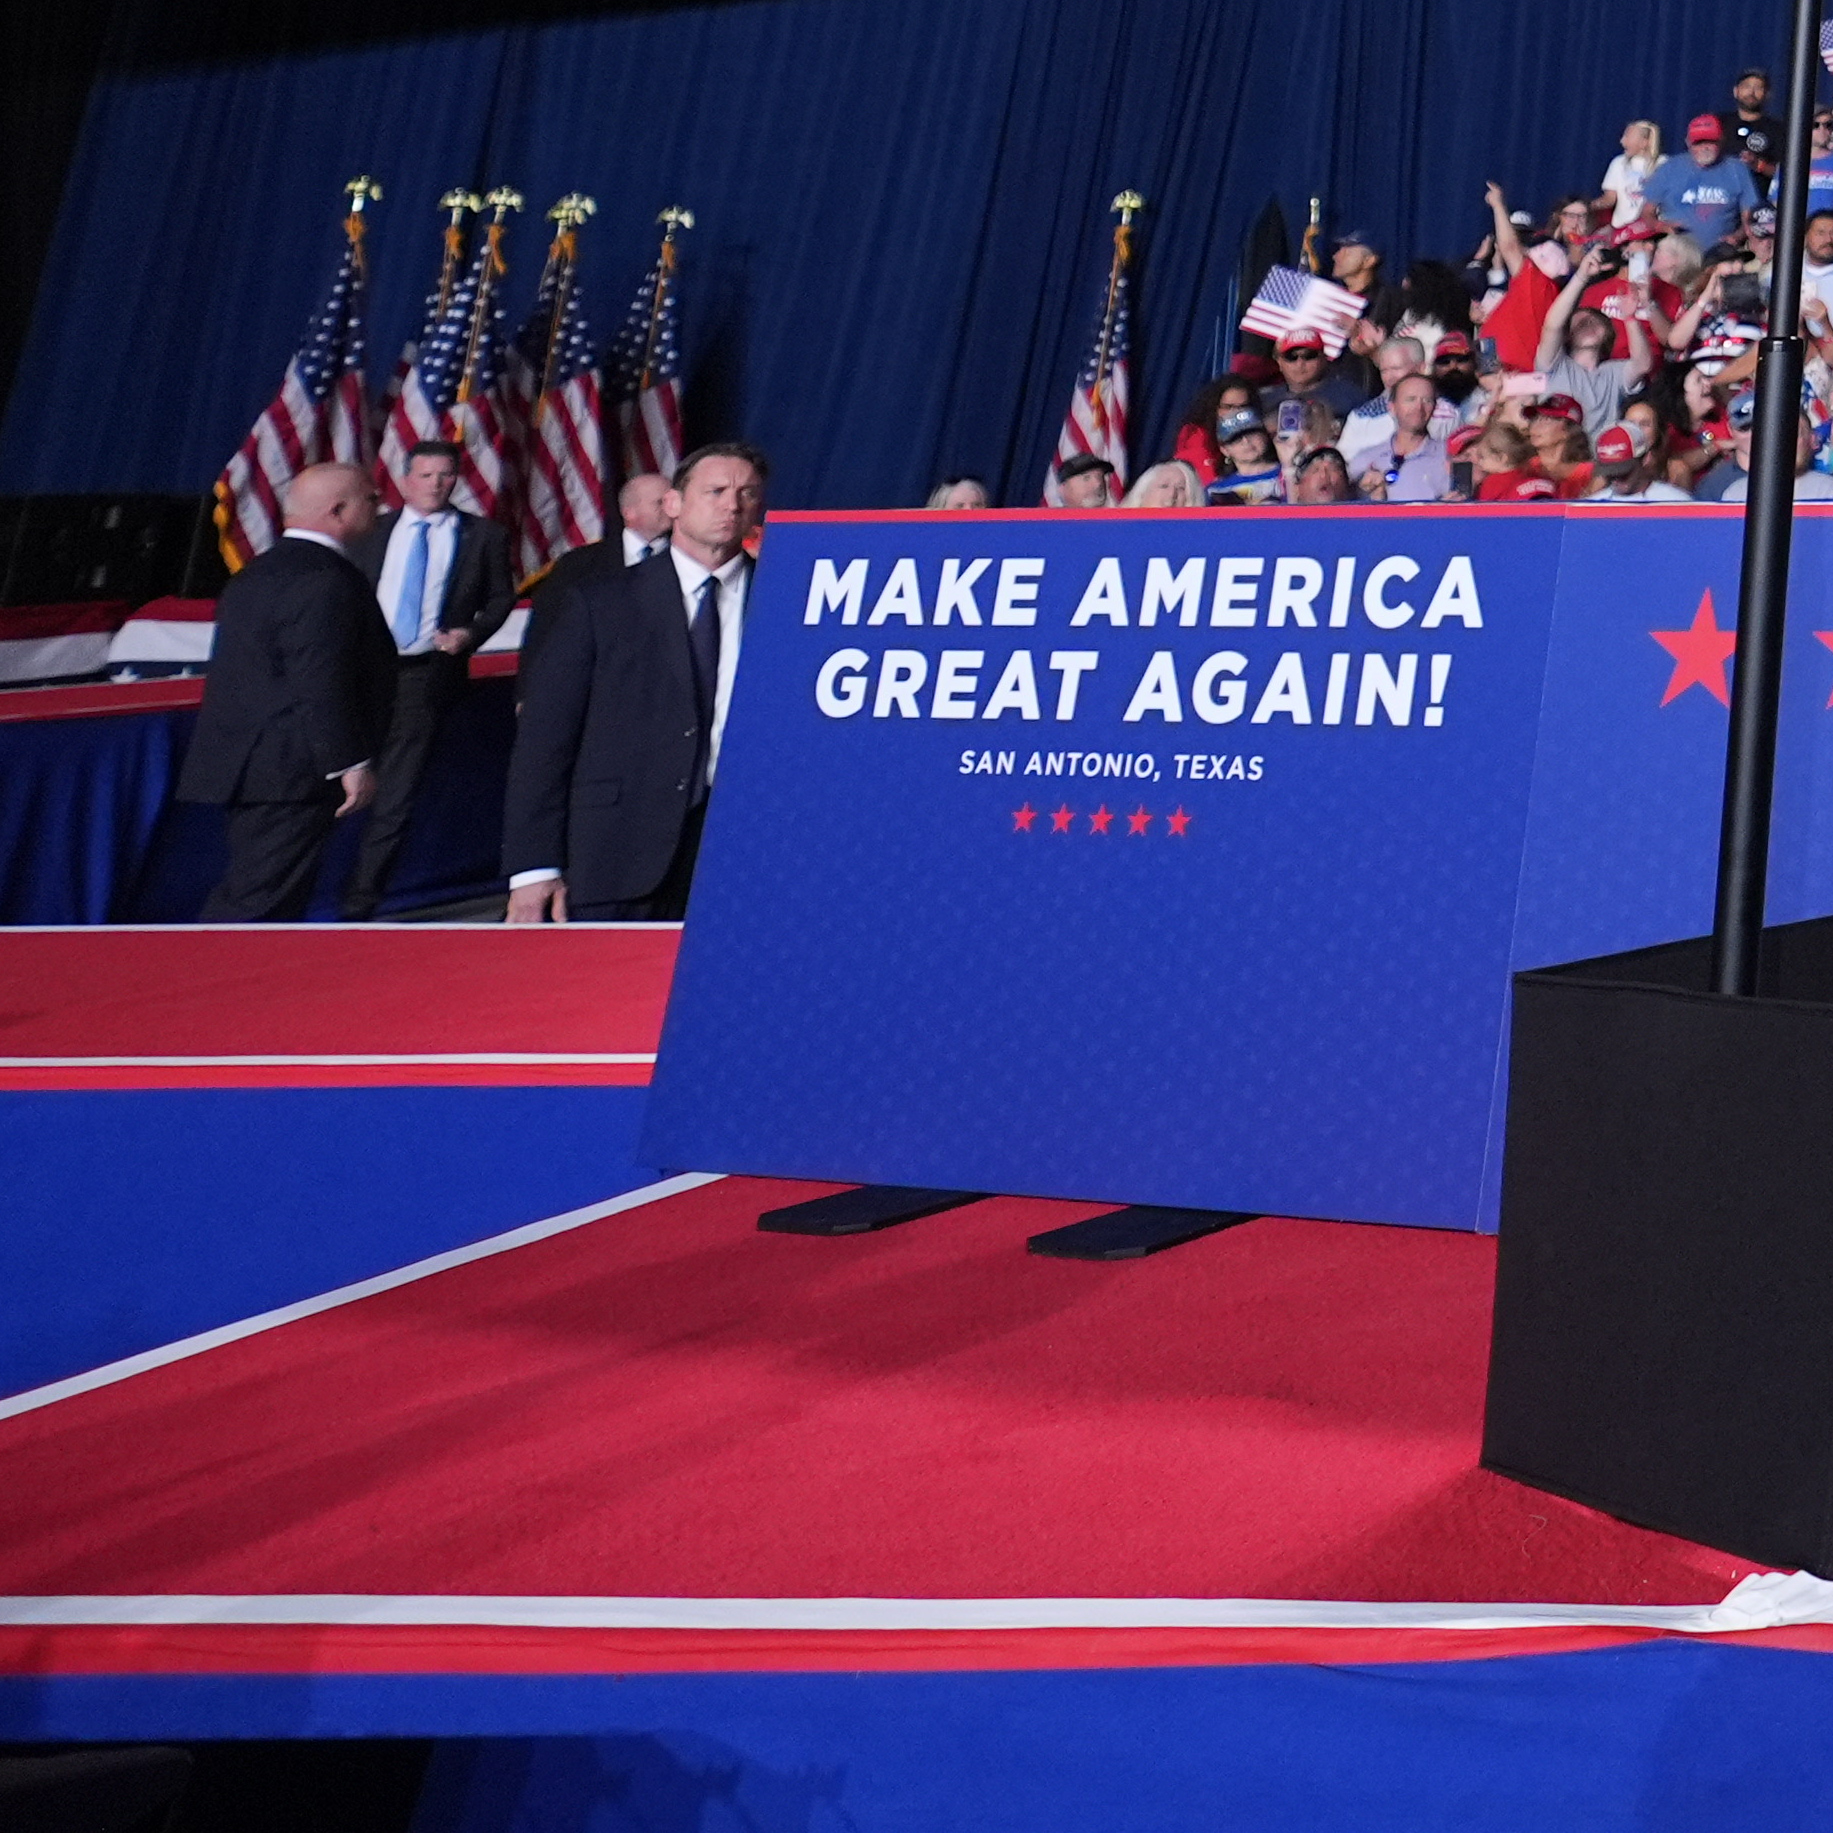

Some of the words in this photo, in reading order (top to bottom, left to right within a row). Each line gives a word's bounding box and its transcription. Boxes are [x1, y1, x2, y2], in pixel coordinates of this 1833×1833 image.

[803, 558, 1046, 627] MAKE
[1069, 555, 1484, 630] AMERICA
[815, 648, 1099, 721] GREAT
[1122, 650, 1453, 728] AGAIN!
[957, 749, 1016, 776] SAN
[1023, 751, 1161, 782] ANTONIO,
[1173, 754, 1265, 782] TEXAS
